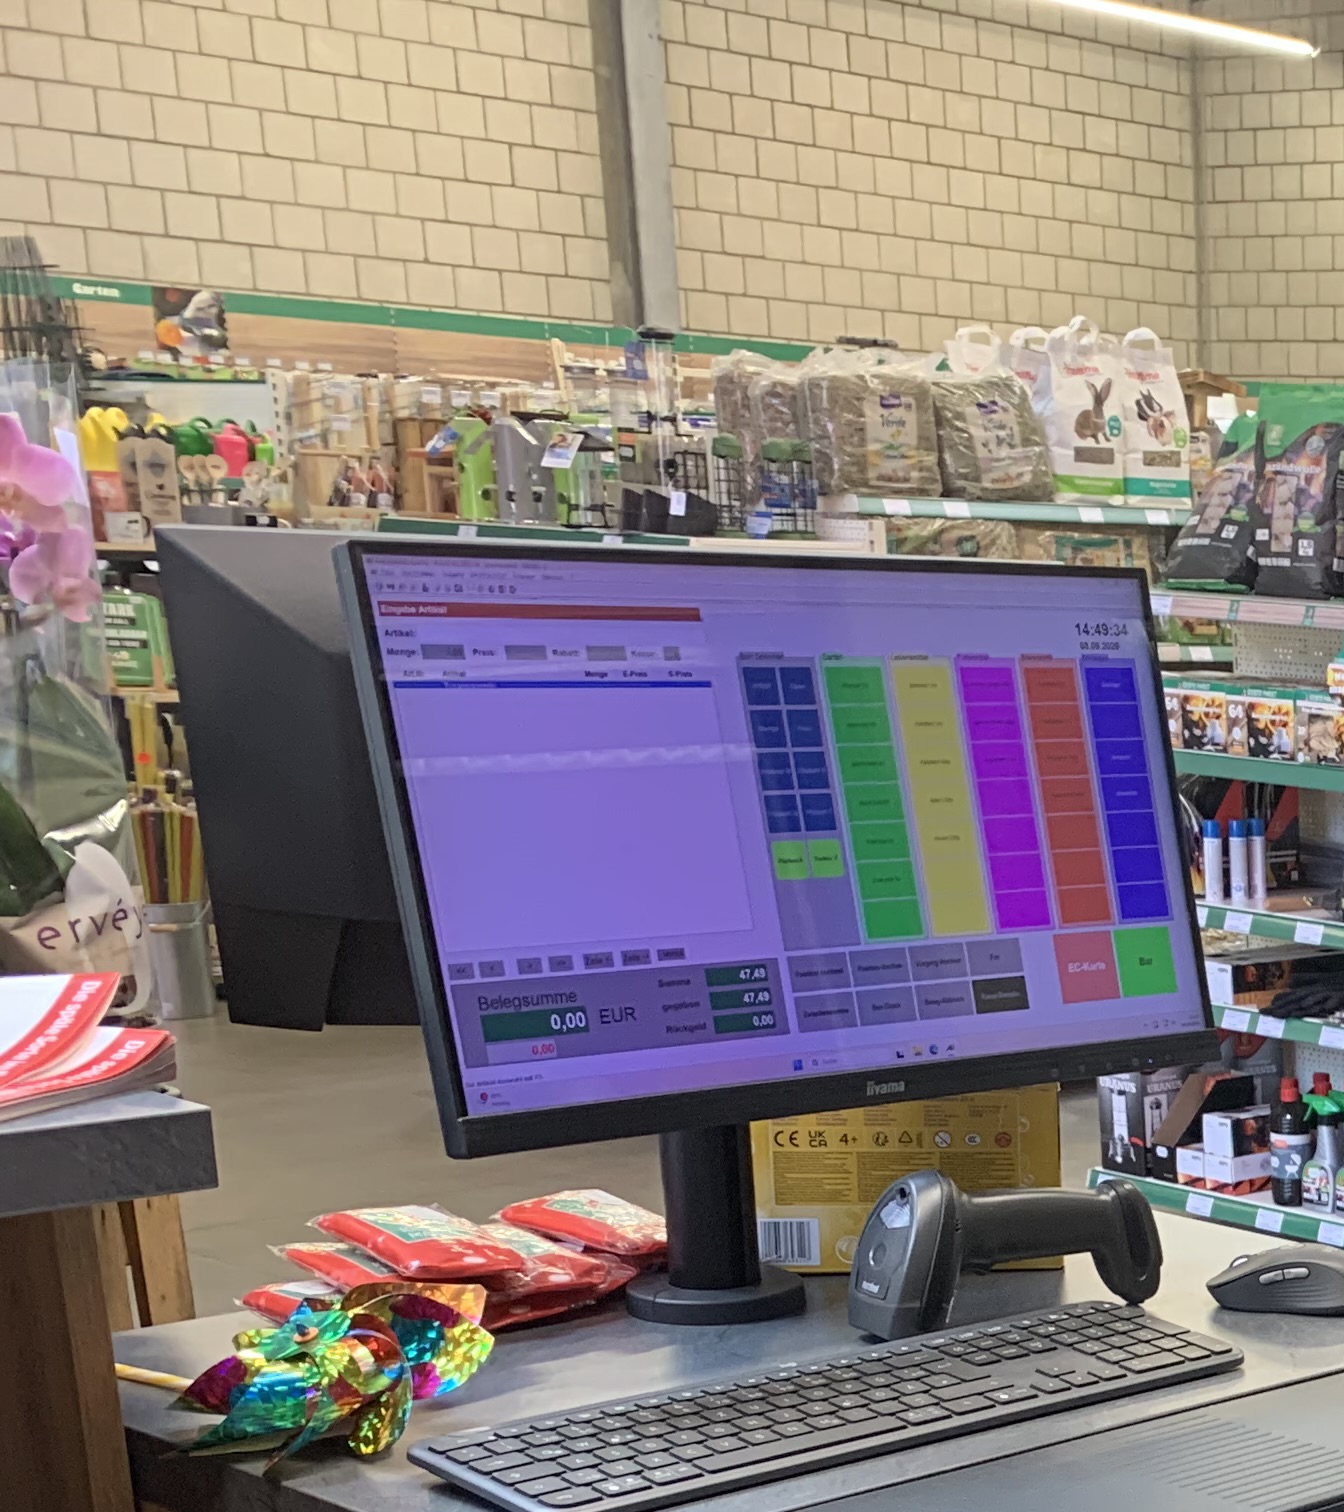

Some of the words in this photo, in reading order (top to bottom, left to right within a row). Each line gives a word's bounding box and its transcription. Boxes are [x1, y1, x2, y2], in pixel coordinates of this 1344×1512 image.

[72, 282, 120, 298] Garten
[1075, 622, 1129, 637] 14:49:34
[477, 990, 578, 1011] Belegsumme
[550, 1011, 587, 1032] 0,00
[599, 1006, 637, 1025] EUR
[752, 1013, 774, 1027] 0,00
[1099, 1078, 1137, 1094] URANUS
[839, 1132, 858, 1146] 4+
